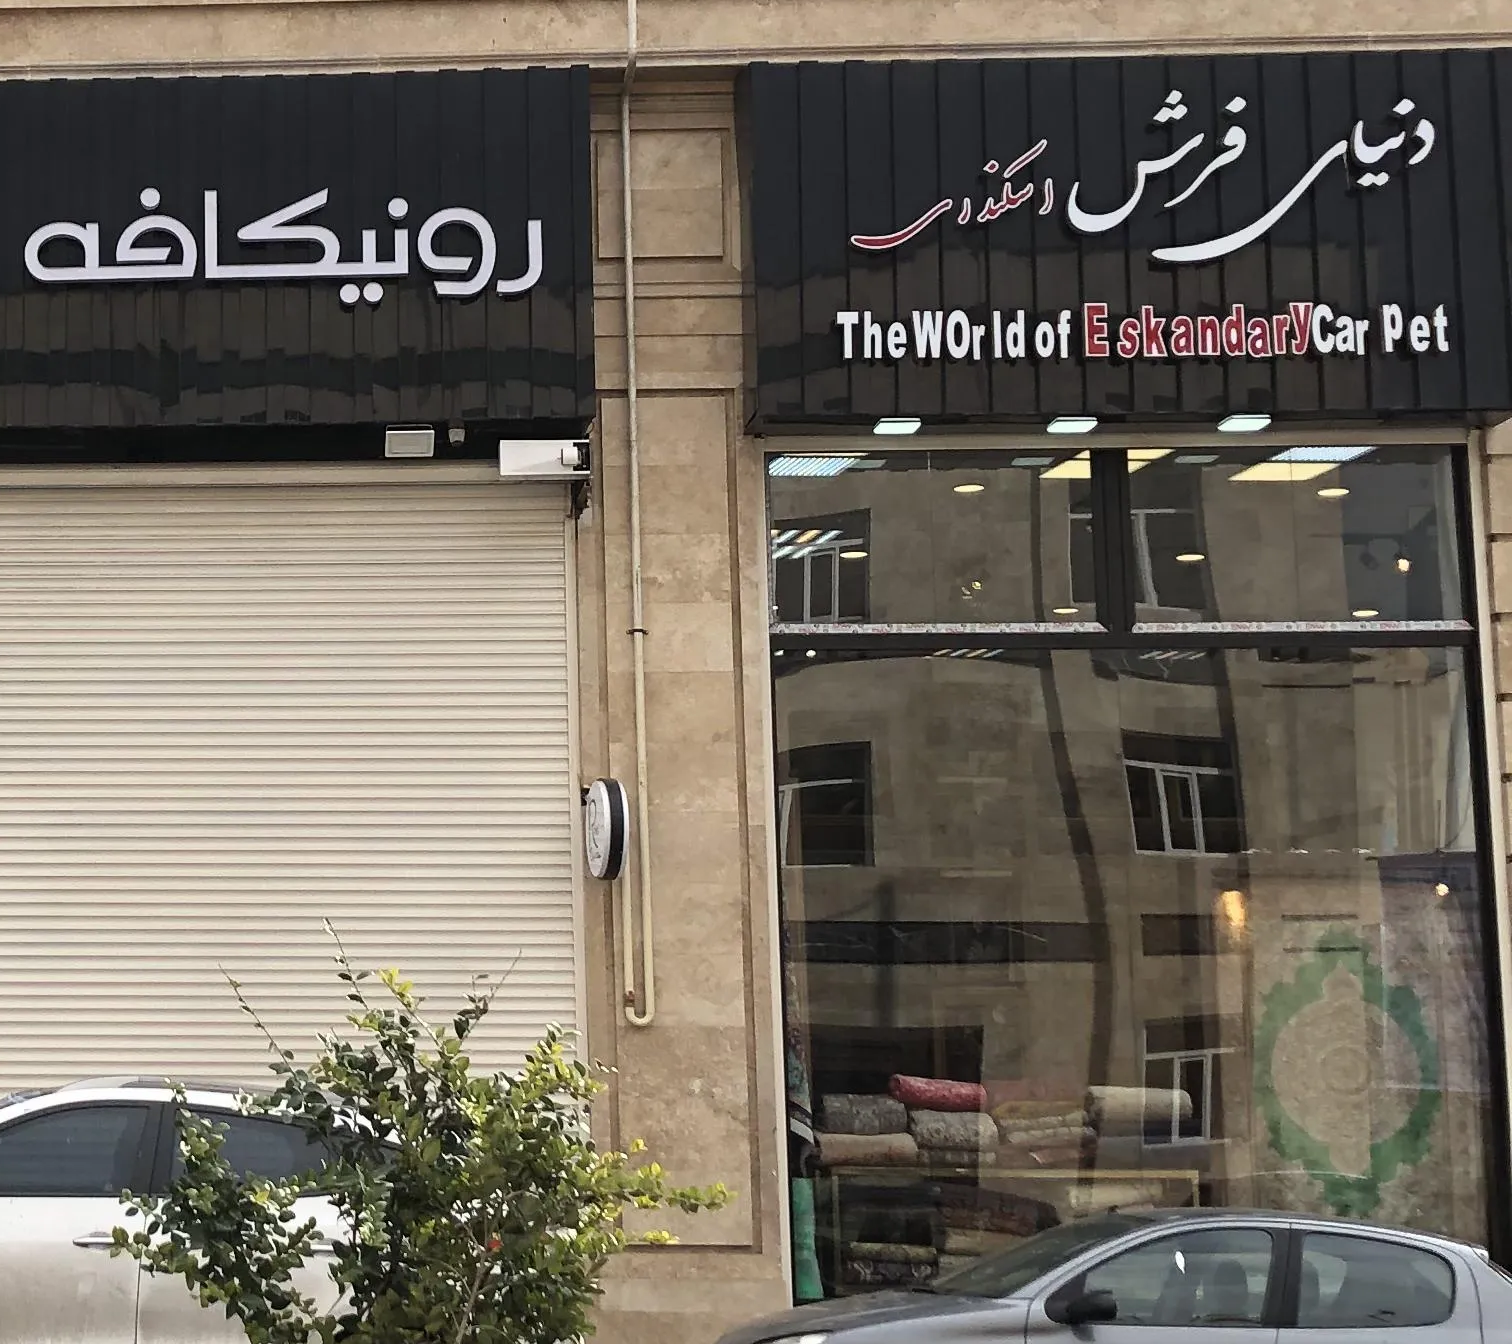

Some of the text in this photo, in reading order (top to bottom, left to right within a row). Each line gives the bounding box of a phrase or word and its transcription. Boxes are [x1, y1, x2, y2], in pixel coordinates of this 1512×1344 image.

[1067, 89, 1248, 234] فرش
[1152, 97, 1436, 263] دنیای
[1034, 309, 1072, 359] of
